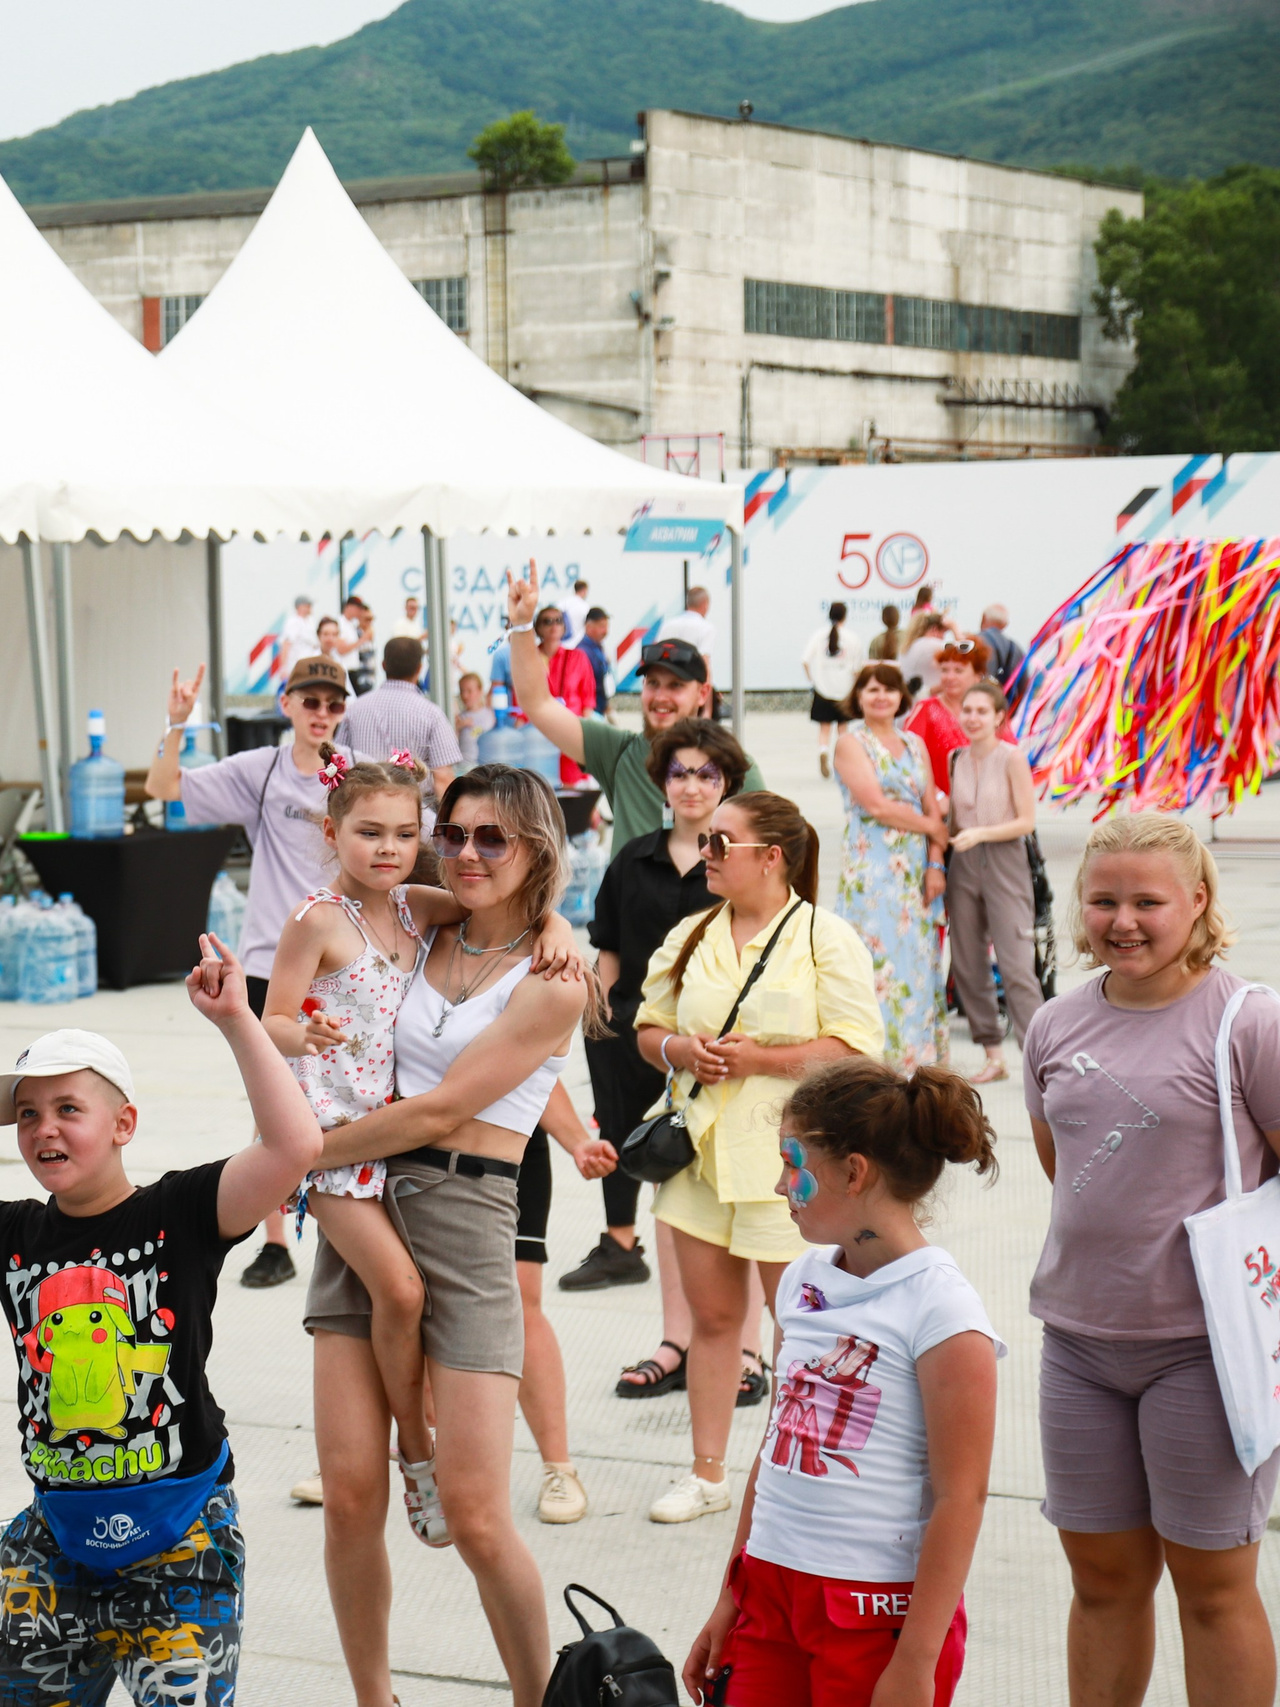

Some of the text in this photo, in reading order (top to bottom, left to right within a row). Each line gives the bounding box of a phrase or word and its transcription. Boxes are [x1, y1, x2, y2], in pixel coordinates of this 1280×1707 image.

[837, 532, 929, 589] 50
[308, 664, 338, 679] NYC
[1244, 1245, 1276, 1288] 52
[131, 1529, 150, 1543] ПОРТ
[850, 1592, 913, 1616] TRE
